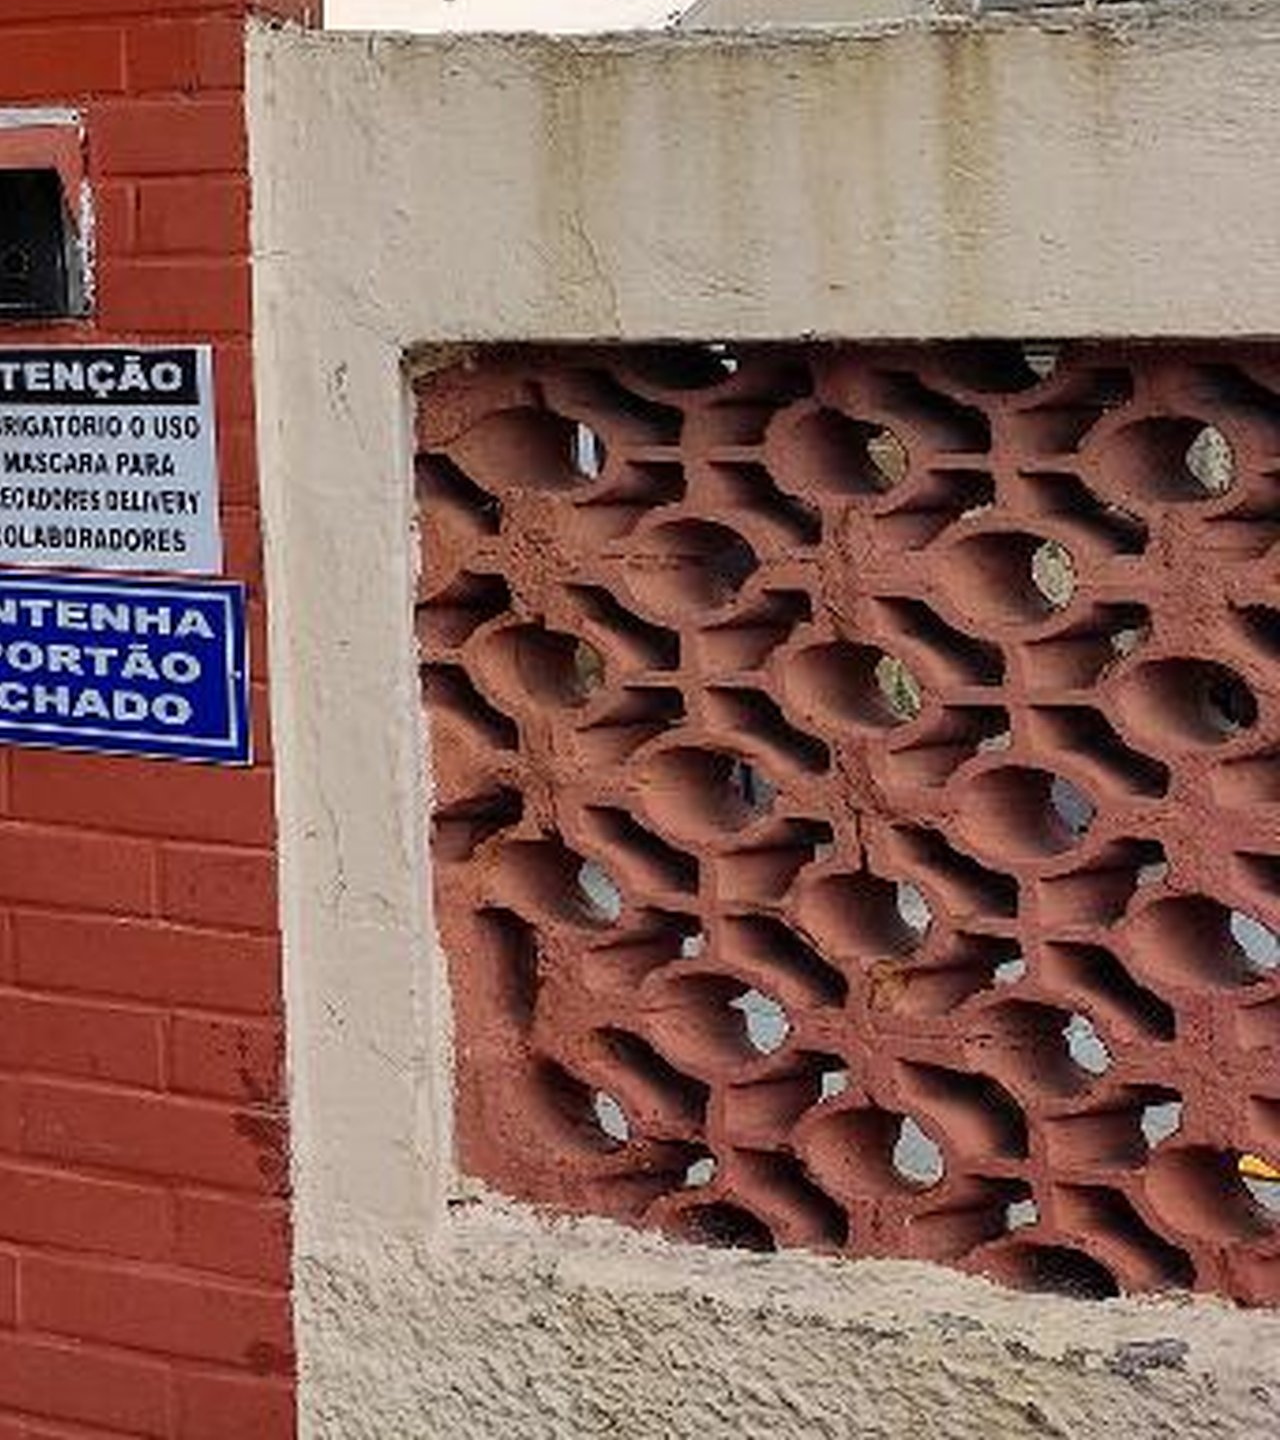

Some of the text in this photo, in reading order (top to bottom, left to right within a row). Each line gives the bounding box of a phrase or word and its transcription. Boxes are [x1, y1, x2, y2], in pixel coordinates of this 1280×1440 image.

[129, 416, 145, 439] O
[153, 416, 201, 439] USO
[116, 453, 175, 477] PARA
